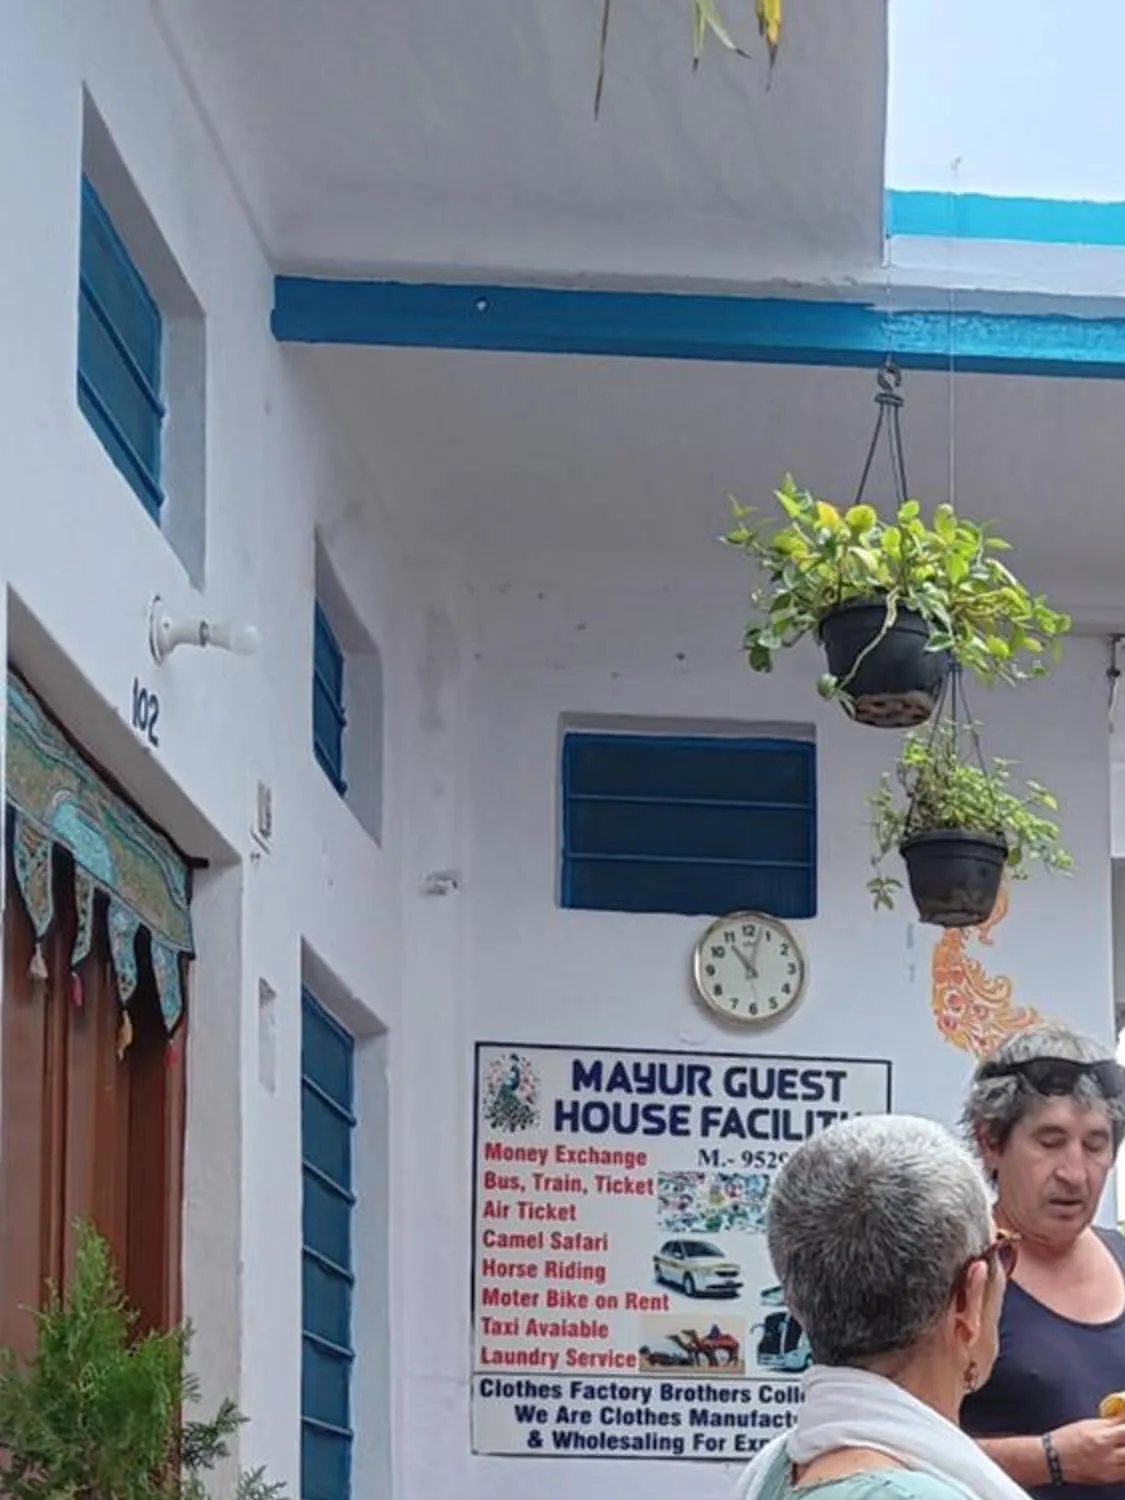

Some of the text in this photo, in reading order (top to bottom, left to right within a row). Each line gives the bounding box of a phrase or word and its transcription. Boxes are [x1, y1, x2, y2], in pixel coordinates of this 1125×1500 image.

[132, 676, 160, 748] 102
[723, 931, 736, 943] 11
[742, 924, 756, 937] 12
[765, 930, 772, 942] 1
[711, 945, 726, 958] 10
[780, 943, 790, 956] 2
[705, 964, 716, 976] 9
[787, 962, 797, 975] 3
[713, 984, 723, 996] 8
[781, 983, 792, 995] 4
[730, 997, 740, 1010] 7
[748, 1002, 759, 1016] 6
[768, 996, 778, 1010] 5
[571, 1059, 847, 1102] MAYUR GUEST
[553, 1100, 862, 1141] HOUSE FACILIT
[484, 1142, 647, 1169] Money Exchange
[484, 1172, 654, 1195] Bus, Train, Ticket
[483, 1202, 576, 1221] Air Ticket
[483, 1230, 608, 1251] Camel Safari
[482, 1260, 606, 1284] Horse Riding
[481, 1289, 669, 1311] Moter Bike on Rent
[481, 1318, 608, 1338] Taxi Avaiable
[480, 1348, 636, 1369] Laundry Service
[480, 1379, 562, 1399] Clothes
[570, 1381, 651, 1403] Factory
[660, 1383, 751, 1403] Brothers
[515, 1405, 547, 1423] We
[556, 1406, 592, 1425] Are
[600, 1407, 681, 1427] Clothes
[527, 1431, 545, 1449] &
[553, 1431, 684, 1455] Wholesaling
[693, 1433, 725, 1451] For
